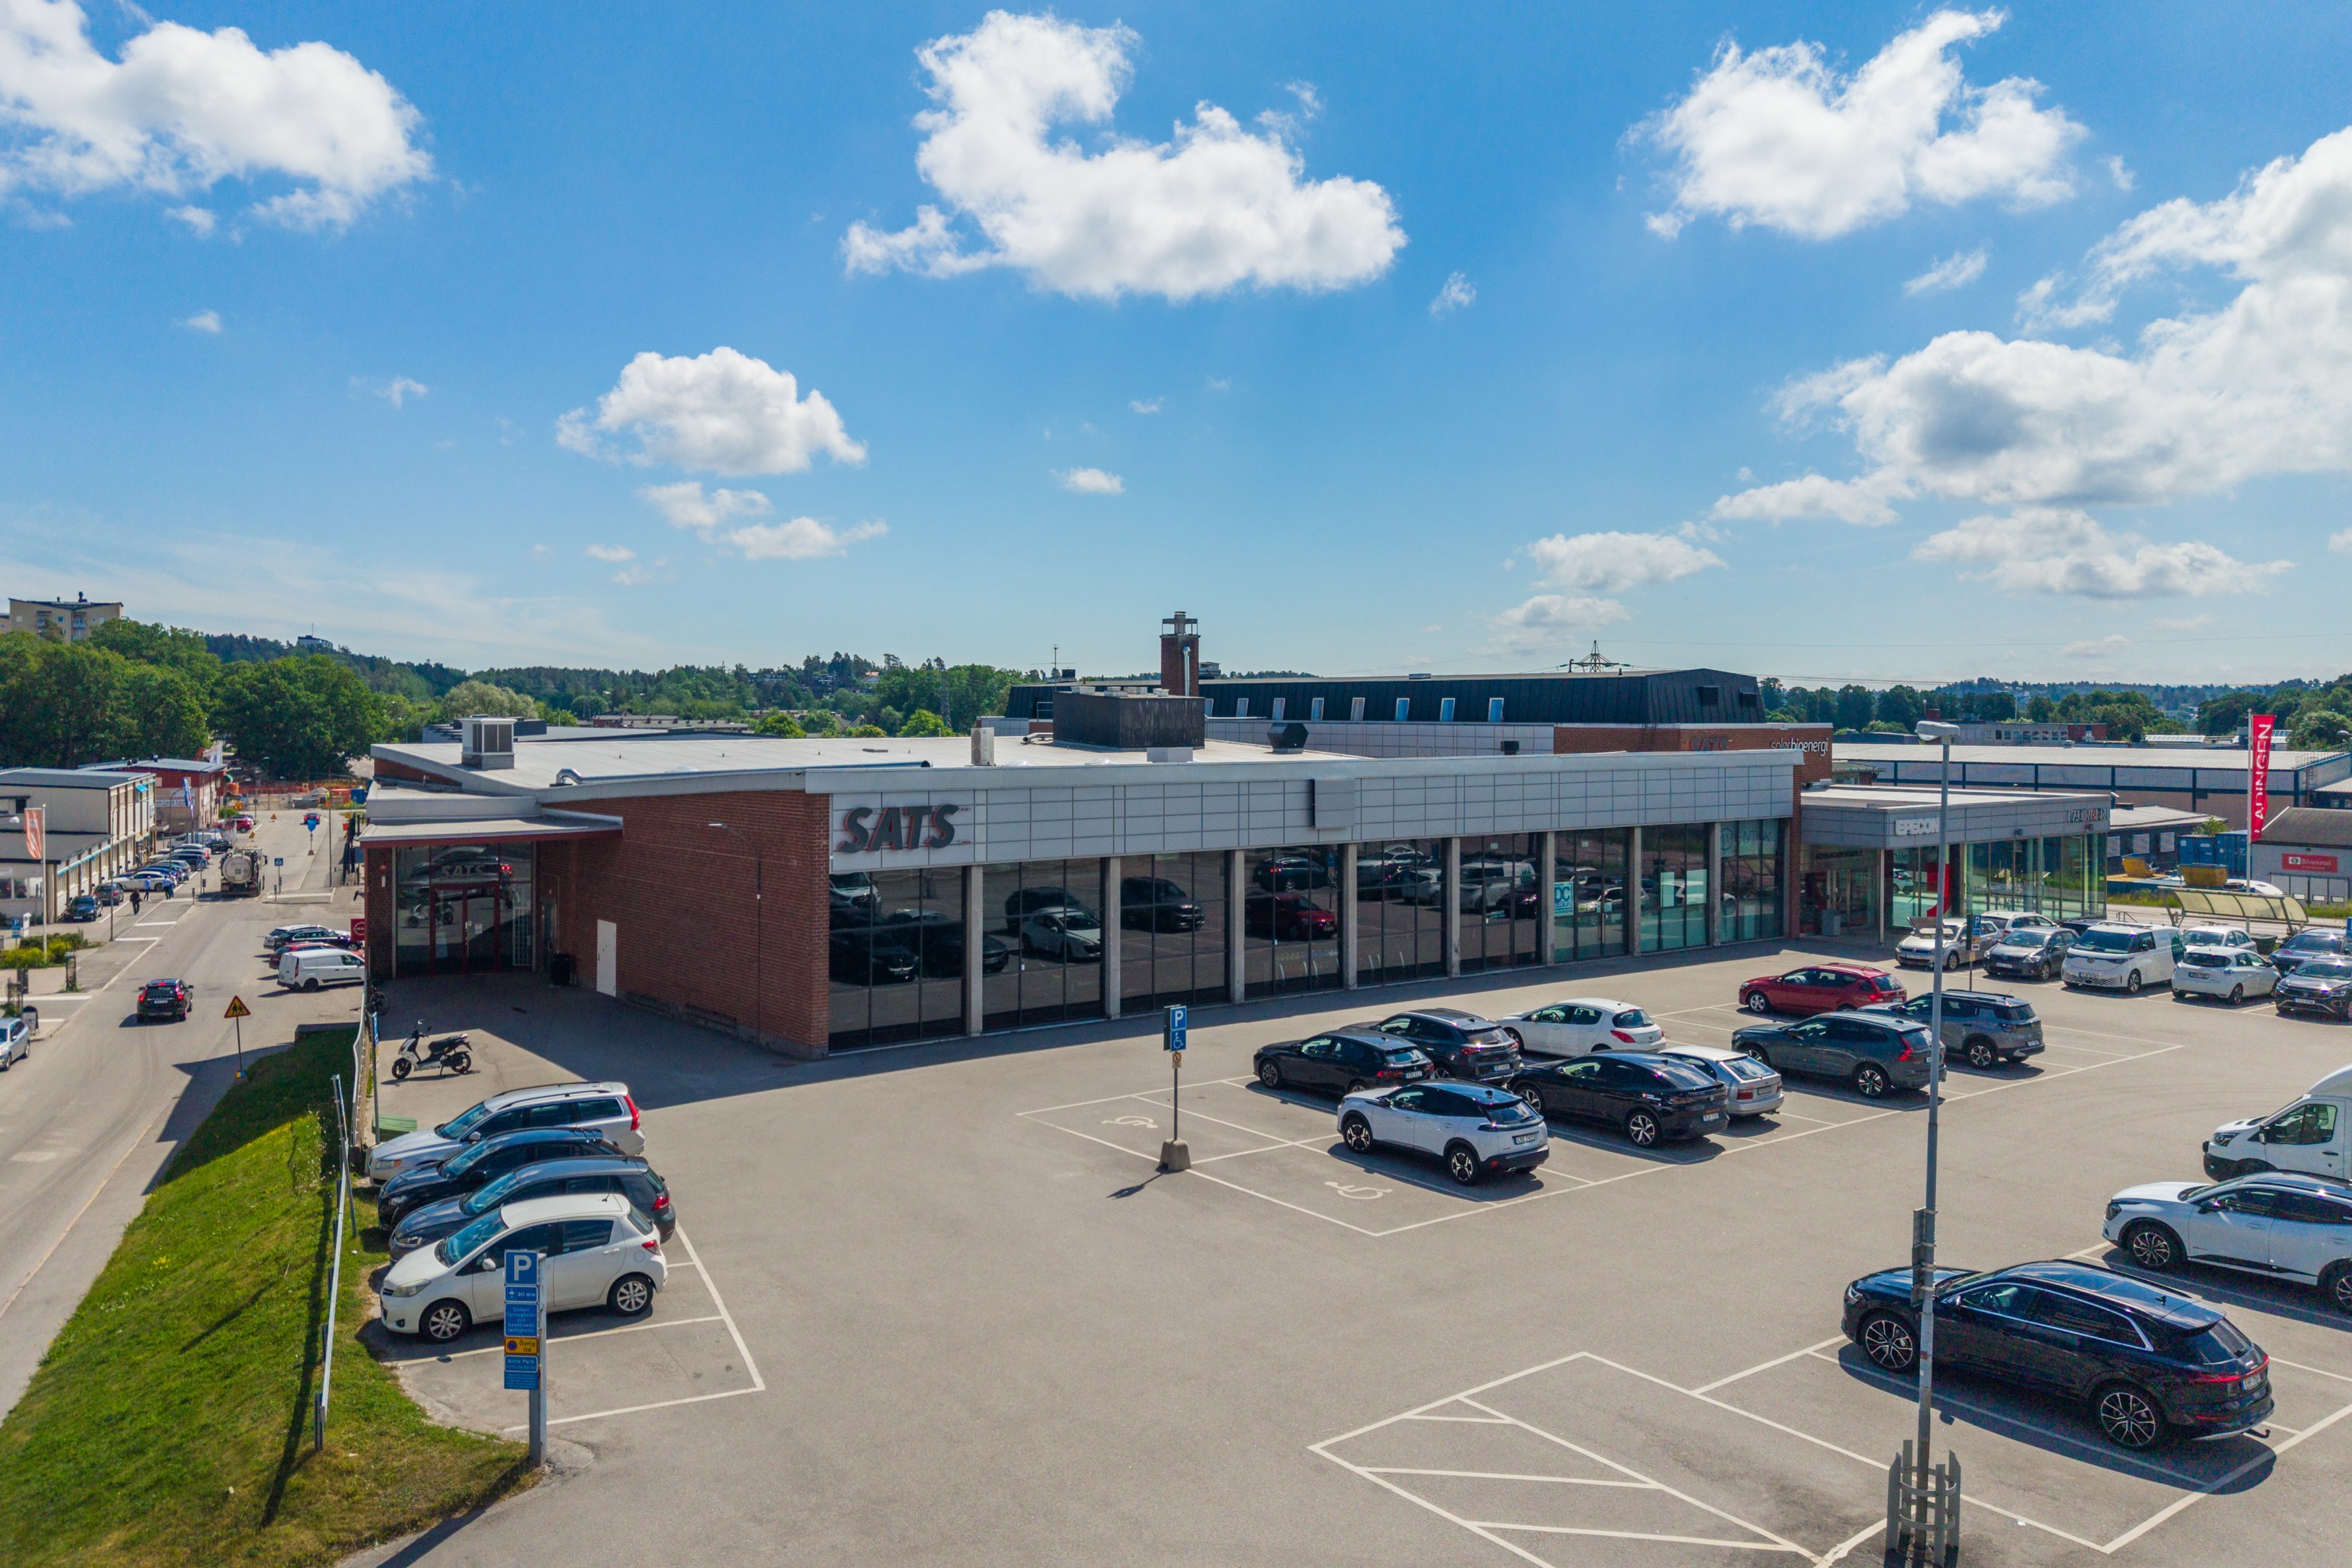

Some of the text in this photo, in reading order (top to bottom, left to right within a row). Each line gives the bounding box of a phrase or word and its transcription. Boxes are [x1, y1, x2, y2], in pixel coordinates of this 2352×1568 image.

[836, 804, 960, 854] SATS
[441, 865, 486, 878] SATS
[1975, 916, 1980, 928] P
[1175, 1010, 1184, 1028] P
[514, 1254, 532, 1281] P
